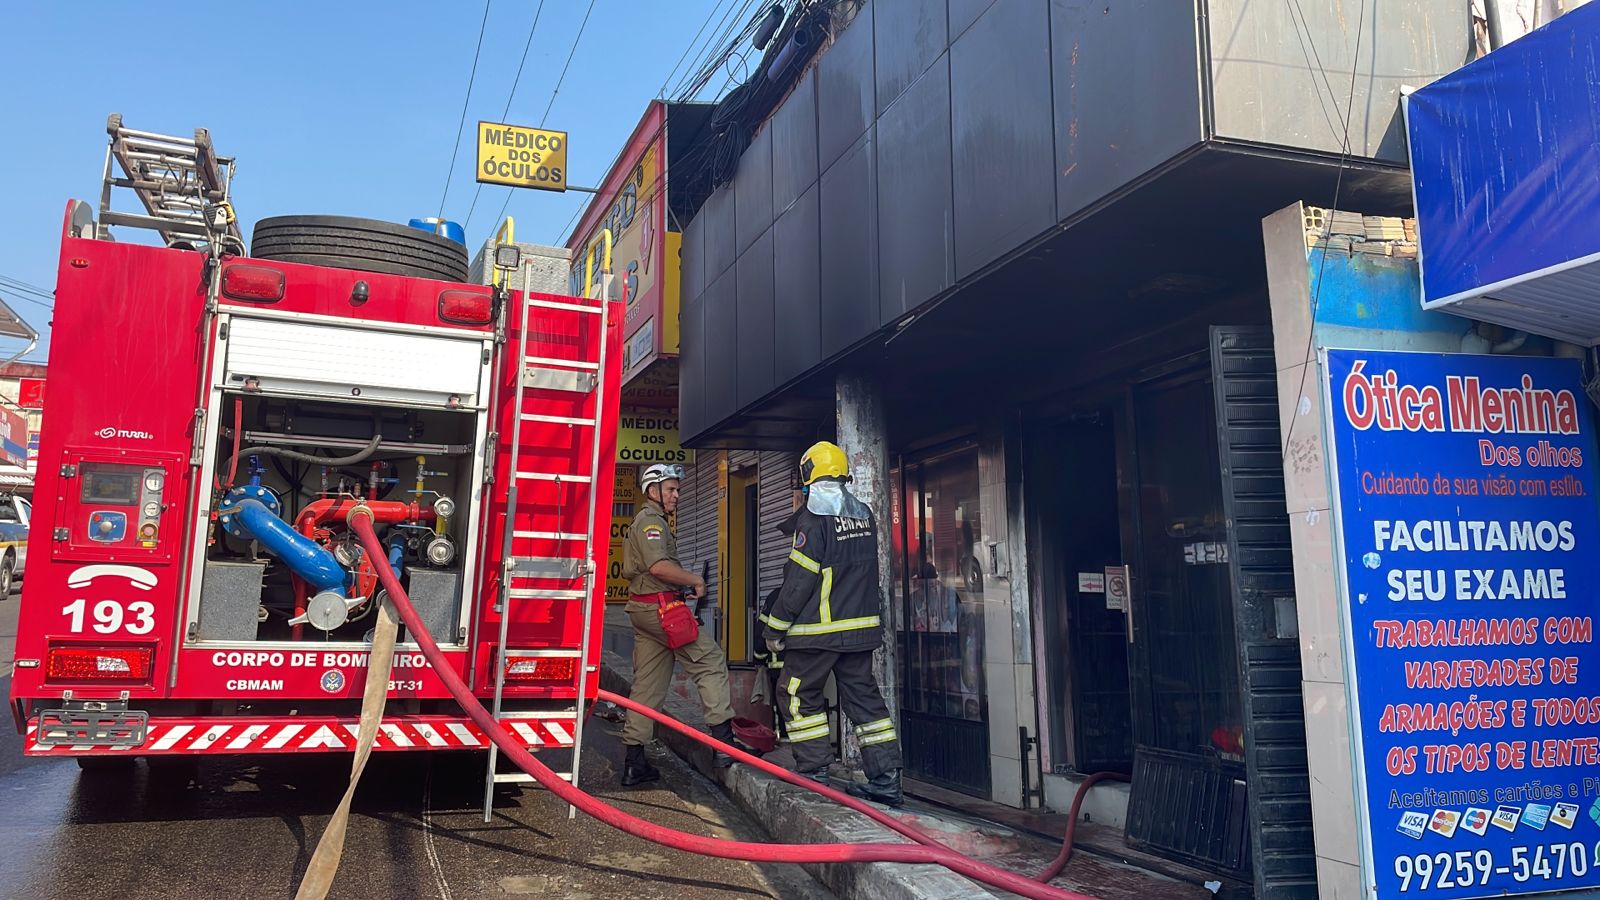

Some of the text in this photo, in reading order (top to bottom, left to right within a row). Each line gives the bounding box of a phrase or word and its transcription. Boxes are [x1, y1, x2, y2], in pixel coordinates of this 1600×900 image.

[485, 127, 562, 152] MÉDICO
[483, 155, 562, 183] ÓCULOS
[508, 149, 541, 164] DOS
[1343, 360, 1580, 435] Ótica Menina
[620, 446, 686, 461] ÓCULOS
[641, 435, 666, 444] DOS
[1478, 439, 1583, 468] Dos olhos
[1361, 471, 1587, 497] Cuidando da sua visão com estilo.
[1374, 520, 1575, 552] FACILITAMOS
[1387, 568, 1567, 602] SEU EXAME
[61, 598, 155, 635] 193
[1373, 616, 1593, 650] TRABALHAMOS COM
[212, 651, 433, 668] CORPO DE BOMIRO
[1404, 656, 1579, 690] VARIEDADES DE
[226, 679, 284, 691] CBMAM
[1378, 694, 1600, 736] ARMAÇÕES E TODOS
[1386, 737, 1600, 776] OS TIPOS DE LENTE
[1388, 787, 1489, 809] Aceitamos
[1494, 779, 1563, 802] cartões
[1568, 783, 1579, 798] e
[1404, 814, 1424, 829] VISA
[1498, 811, 1514, 823] VISA
[1394, 841, 1588, 893] 99259-5470
